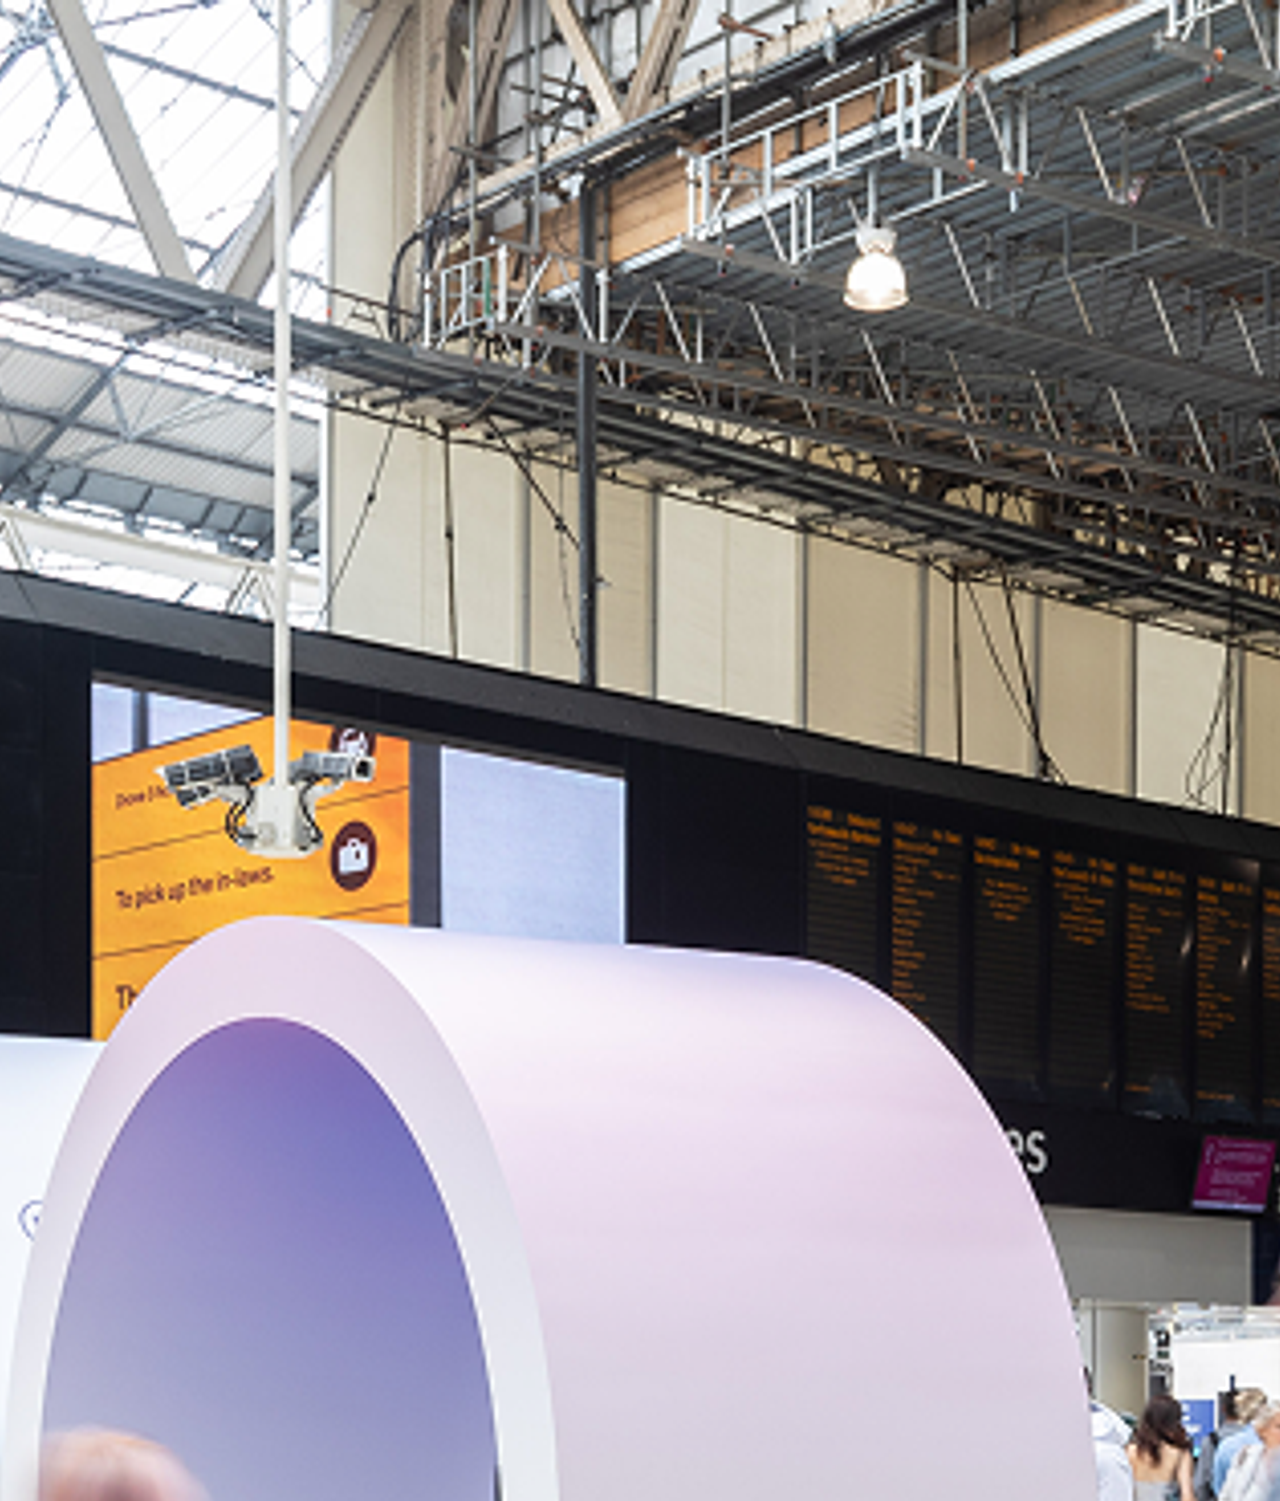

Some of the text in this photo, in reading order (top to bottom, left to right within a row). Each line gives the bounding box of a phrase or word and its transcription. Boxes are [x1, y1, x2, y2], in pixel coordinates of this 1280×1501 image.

[115, 890, 132, 909] To
[135, 883, 165, 909] pick
[168, 882, 185, 903] up
[188, 875, 213, 895] the
